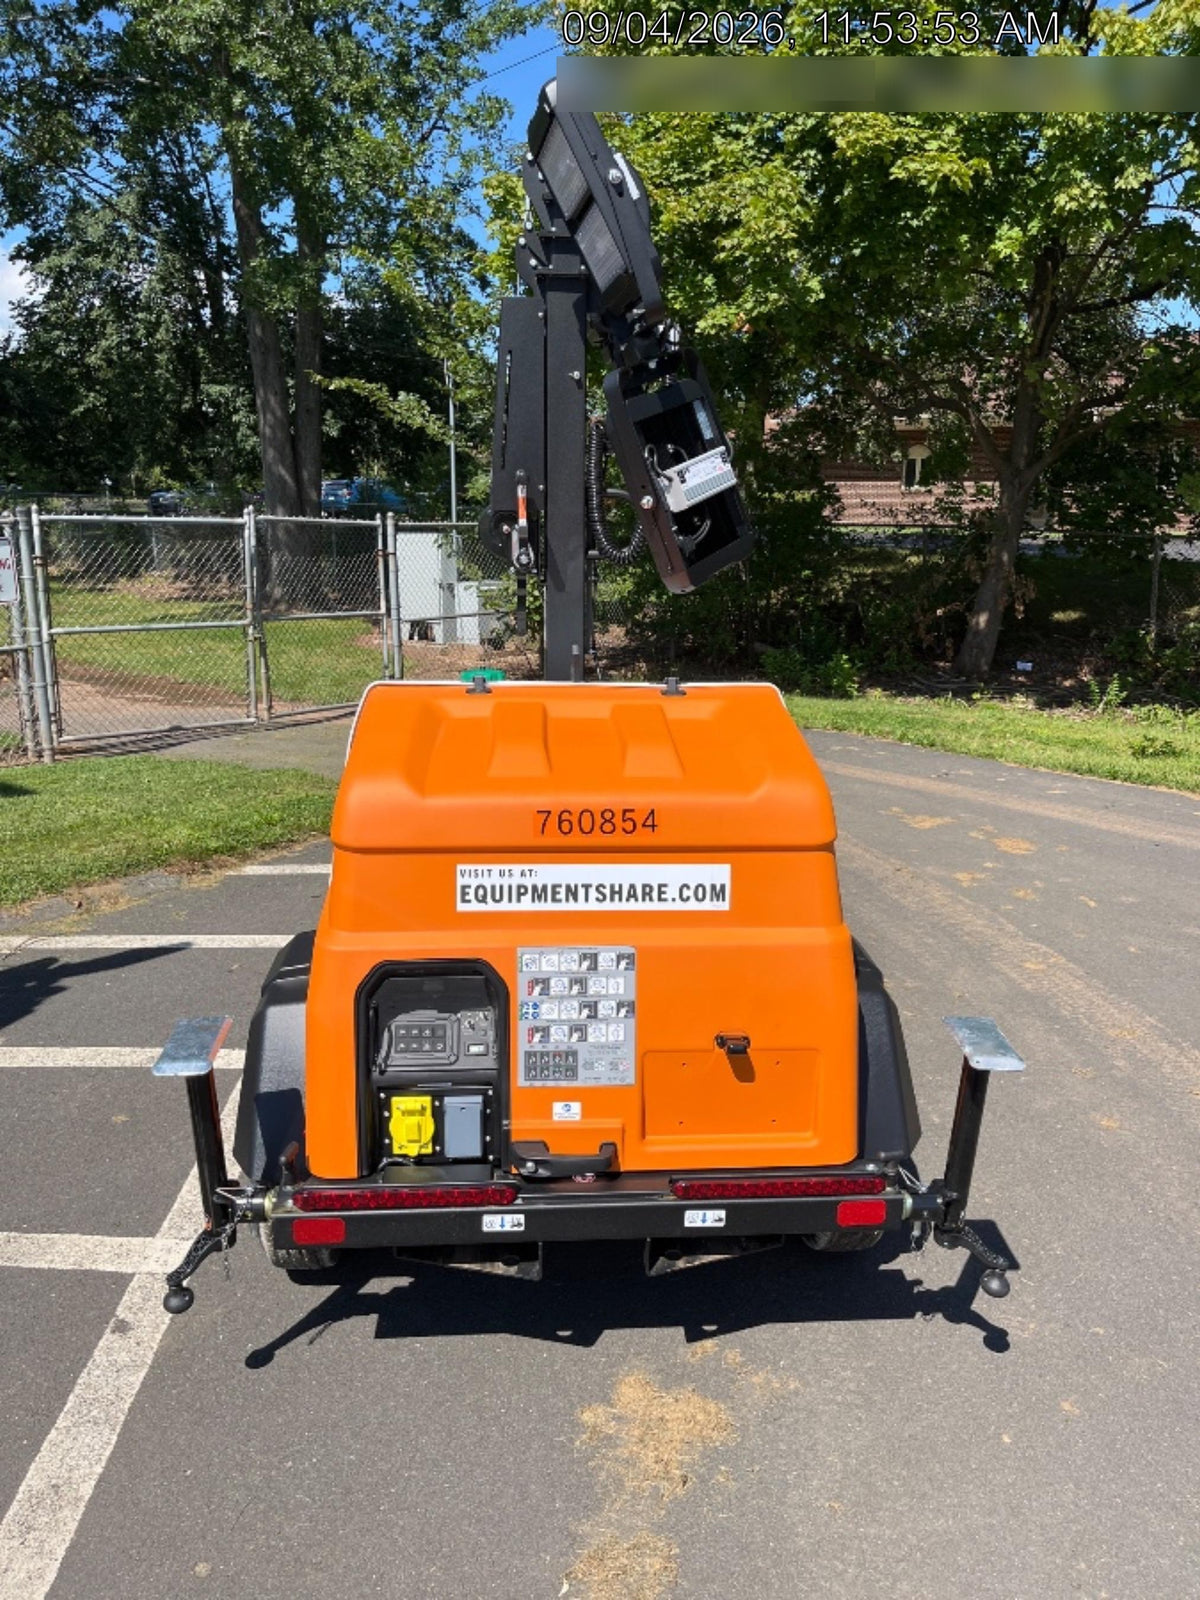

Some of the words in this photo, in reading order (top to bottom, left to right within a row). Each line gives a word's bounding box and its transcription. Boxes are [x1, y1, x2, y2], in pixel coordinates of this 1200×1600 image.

[536, 808, 659, 836] 760854
[459, 868, 493, 879] VISIT
[498, 868, 514, 879] US
[520, 868, 538, 878] AT:
[459, 882, 727, 905] EQUIPMENTSHARE.COM
